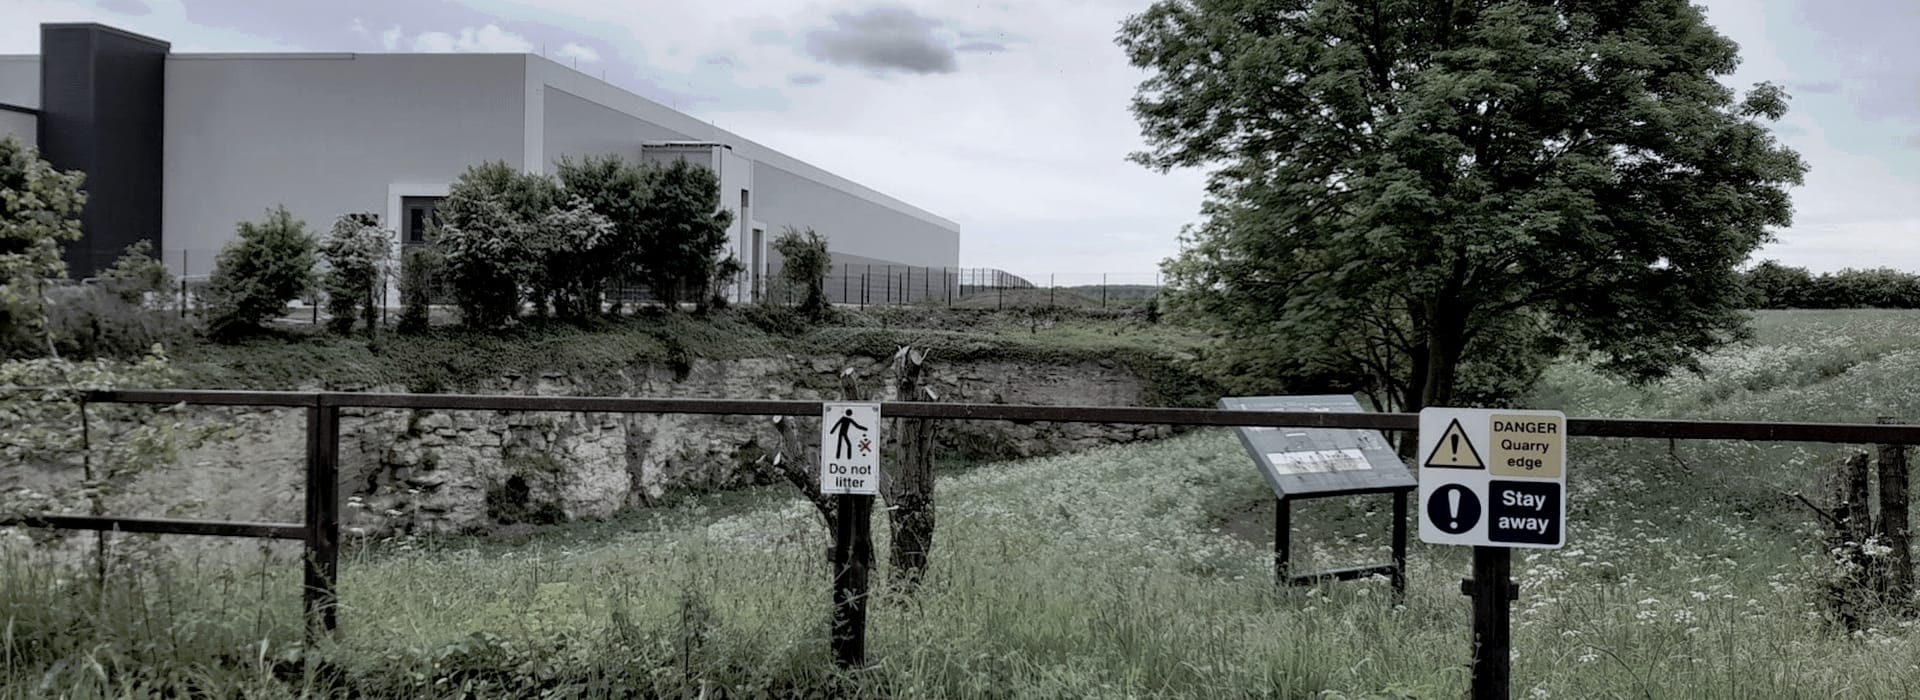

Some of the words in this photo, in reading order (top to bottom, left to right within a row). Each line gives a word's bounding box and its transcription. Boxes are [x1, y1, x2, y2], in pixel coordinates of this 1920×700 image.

[1494, 421, 1557, 434] DANGER
[1501, 439, 1549, 454] Quarry
[829, 463, 847, 474] Do
[851, 464, 871, 475] not
[1507, 457, 1543, 470] edge
[835, 477, 865, 488] litter
[1502, 490, 1546, 511] Stay
[1498, 516, 1549, 535] away
